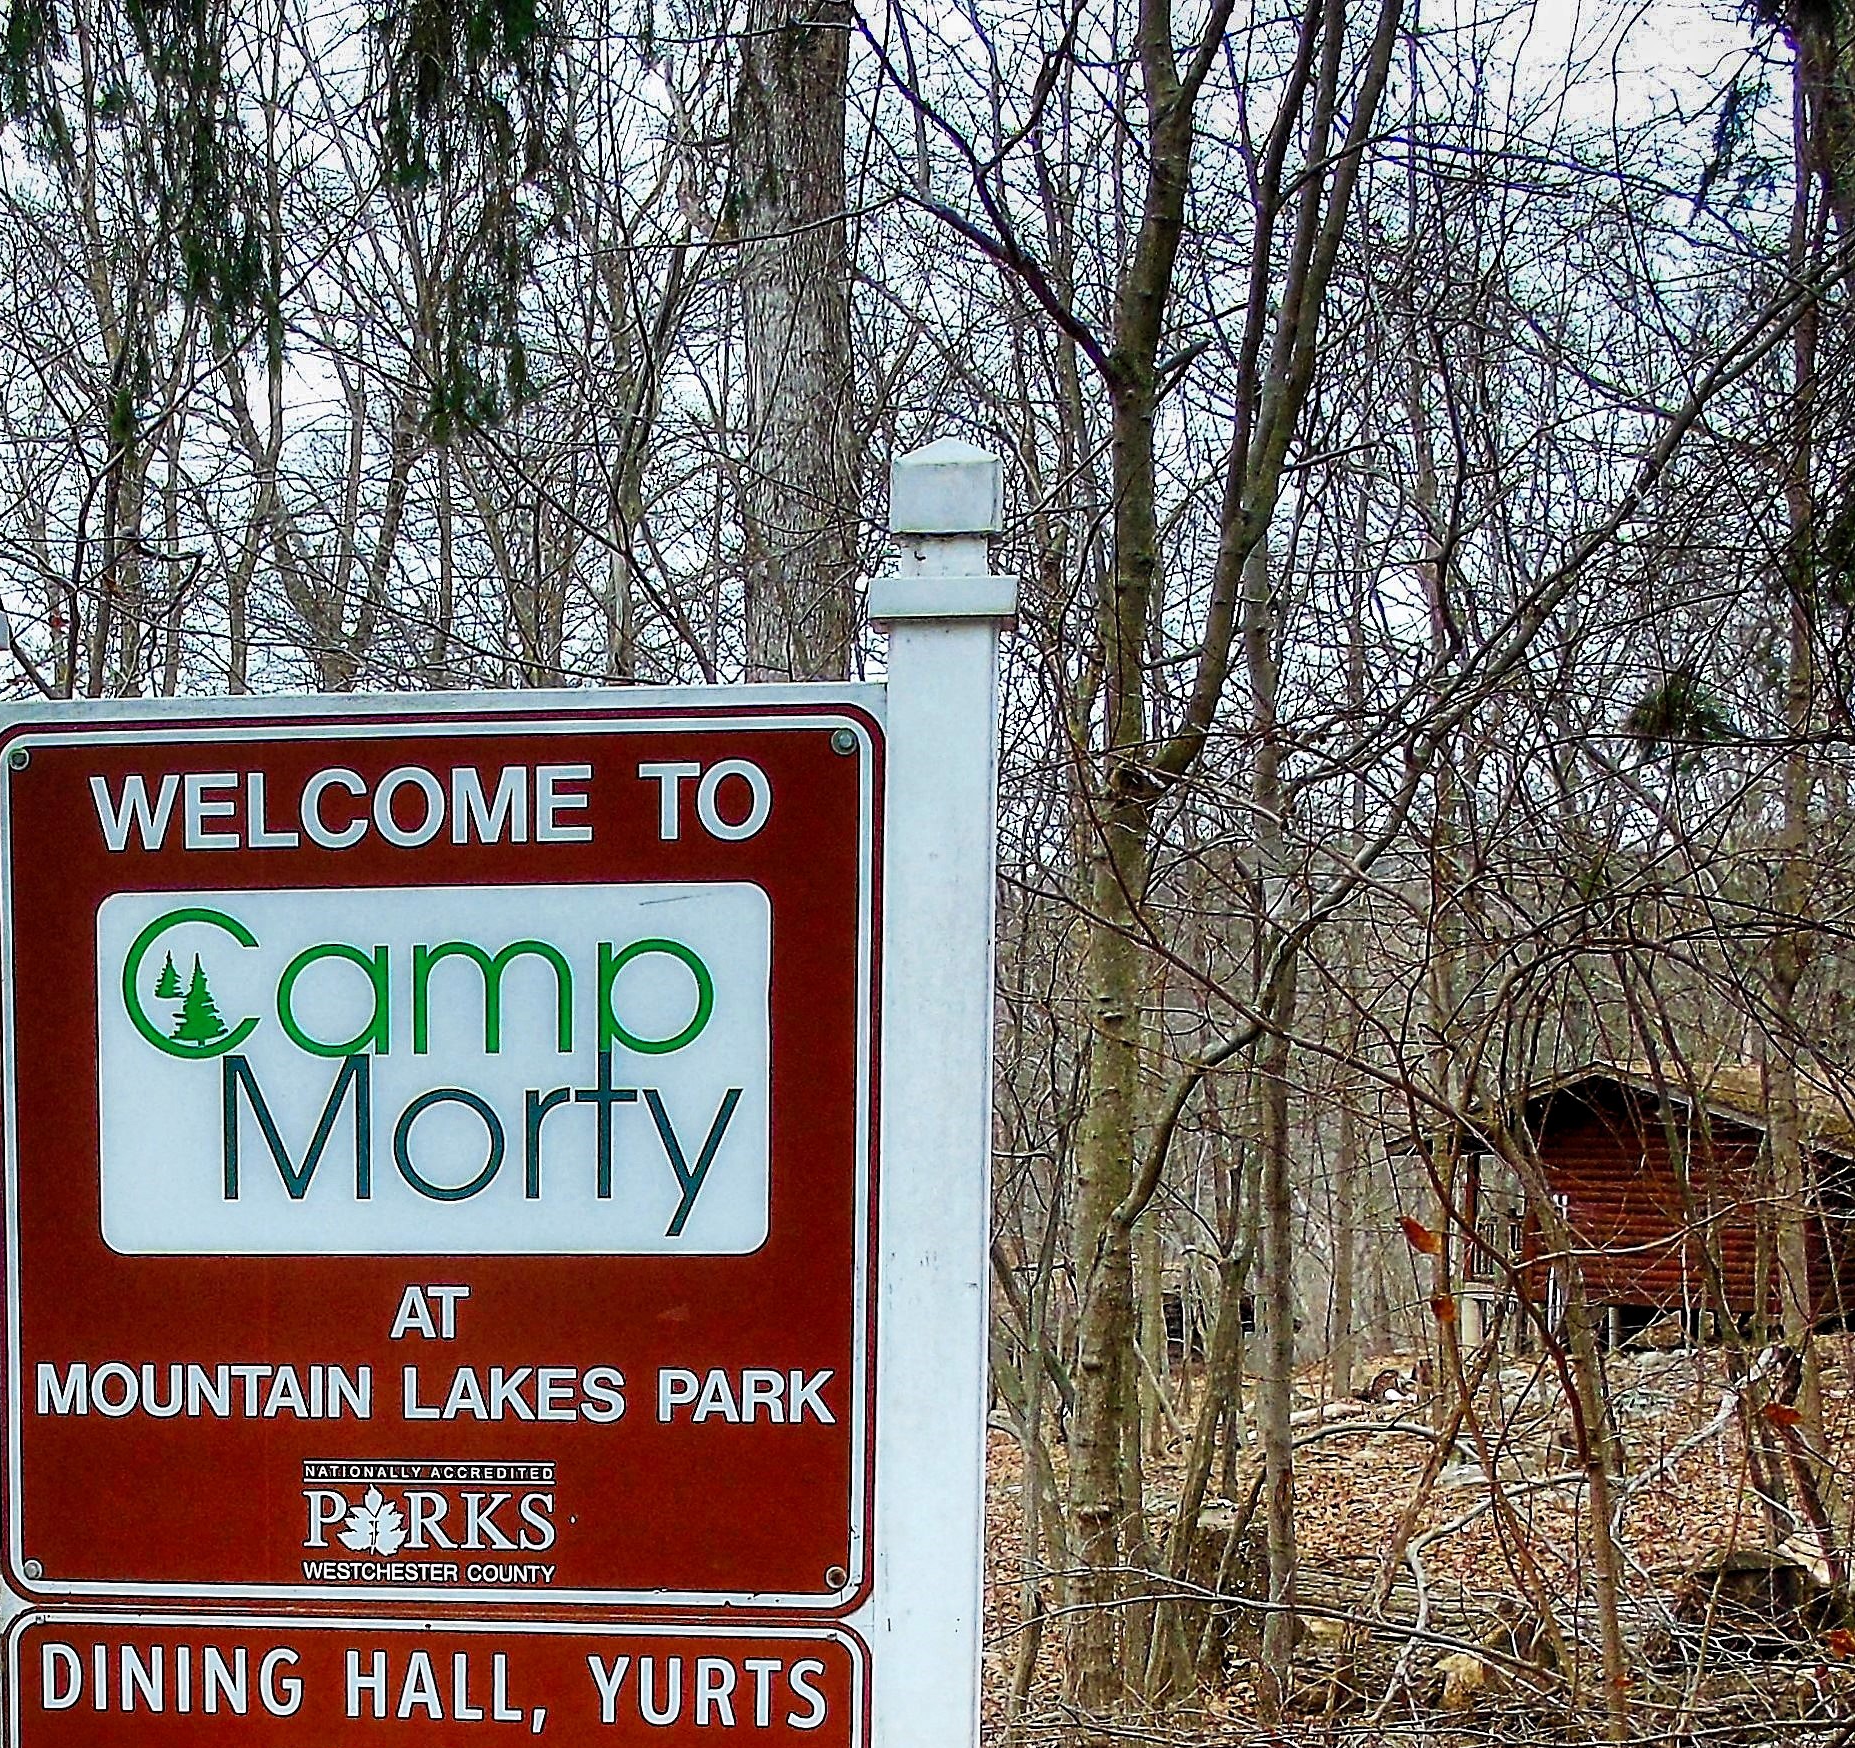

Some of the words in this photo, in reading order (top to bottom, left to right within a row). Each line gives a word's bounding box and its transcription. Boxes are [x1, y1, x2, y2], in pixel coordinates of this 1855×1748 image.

[88, 763, 594, 852] WELCOME
[637, 758, 772, 842] TO
[122, 908, 716, 1058] Camp
[222, 1053, 743, 1238] Morty
[389, 1285, 471, 1340] AT
[36, 1361, 372, 1420] MOUNTAIN
[403, 1364, 626, 1424] LAKES
[658, 1368, 837, 1424] PARK
[304, 1464, 423, 1479] NATIONALLY
[429, 1466, 554, 1481] ACCREDITED
[302, 1560, 459, 1582] WESTCHESTER
[466, 1563, 556, 1584] COUNTY
[41, 1642, 303, 1717] DINING
[345, 1649, 548, 1734] HALL,
[586, 1655, 827, 1730] YURTS
